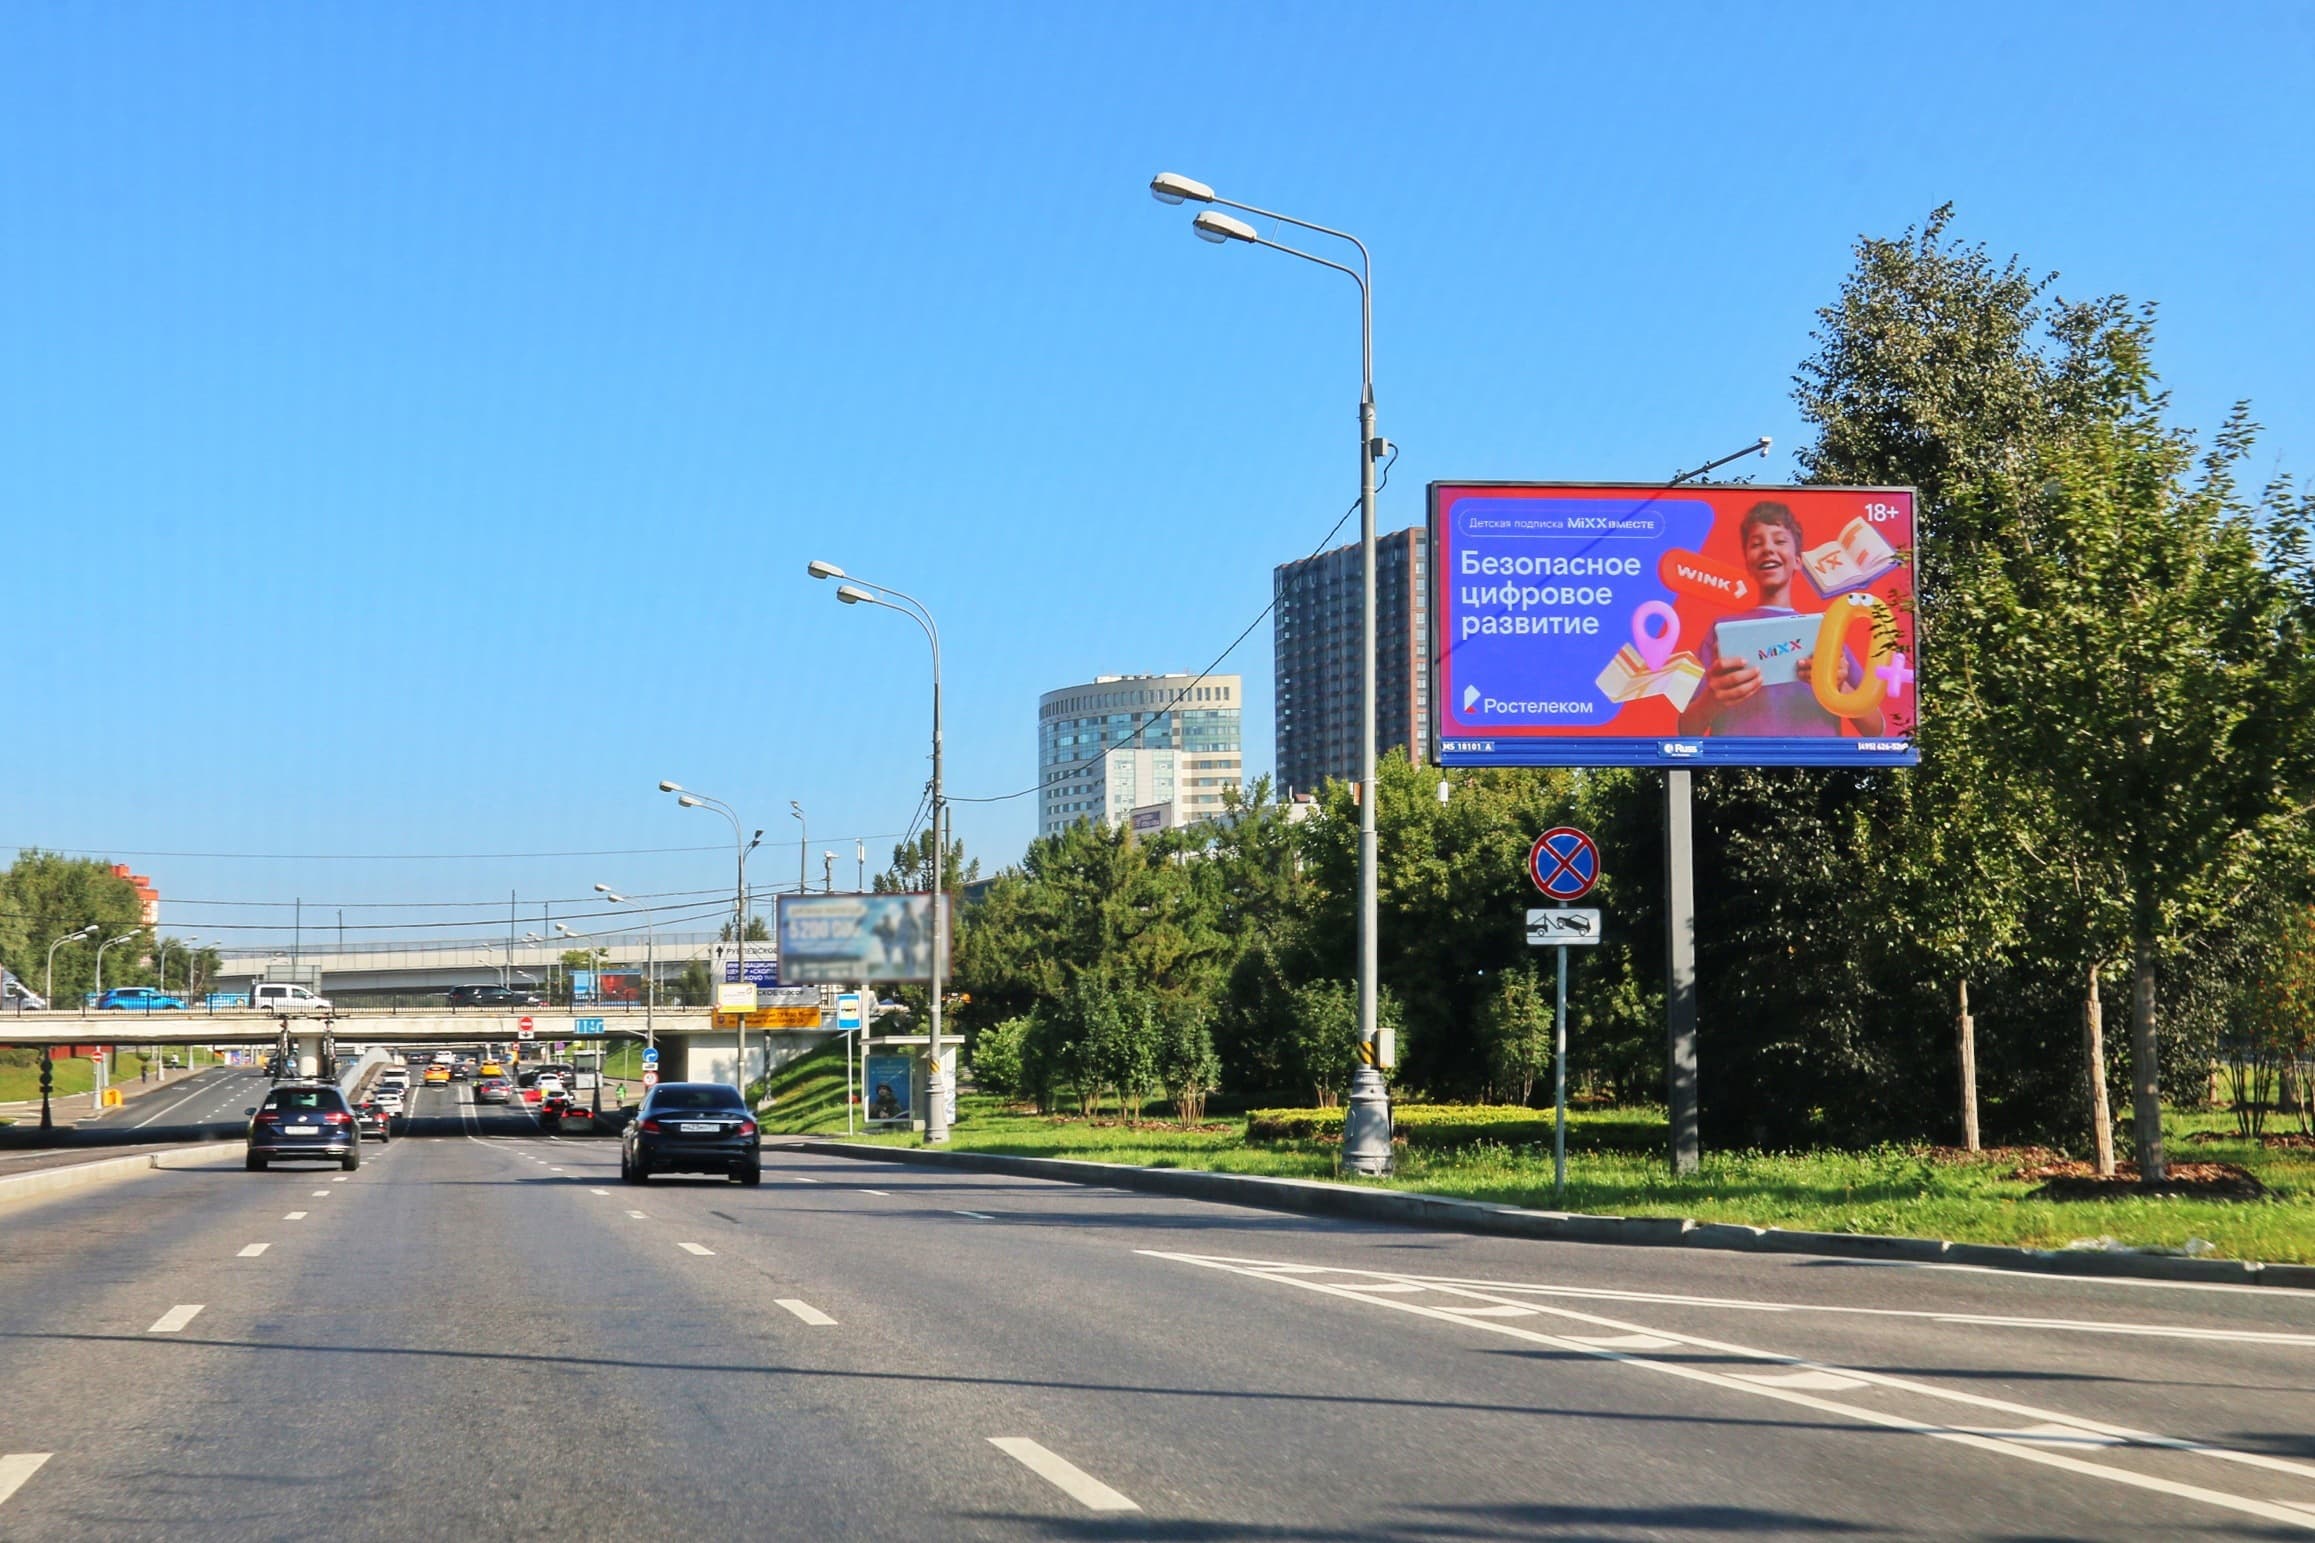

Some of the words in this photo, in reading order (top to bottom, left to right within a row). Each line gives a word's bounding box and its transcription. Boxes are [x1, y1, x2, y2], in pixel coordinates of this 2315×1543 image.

[1469, 517, 1511, 529] Детская
[1514, 520, 1563, 530] подписка
[1865, 503, 1899, 522] 18+
[1461, 549, 1641, 576] Безопасное
[1676, 564, 1732, 593] WINK
[1461, 580, 1613, 611] цифровое
[1462, 615, 1600, 641] развитие
[1484, 698, 1593, 713] Ростелеком
